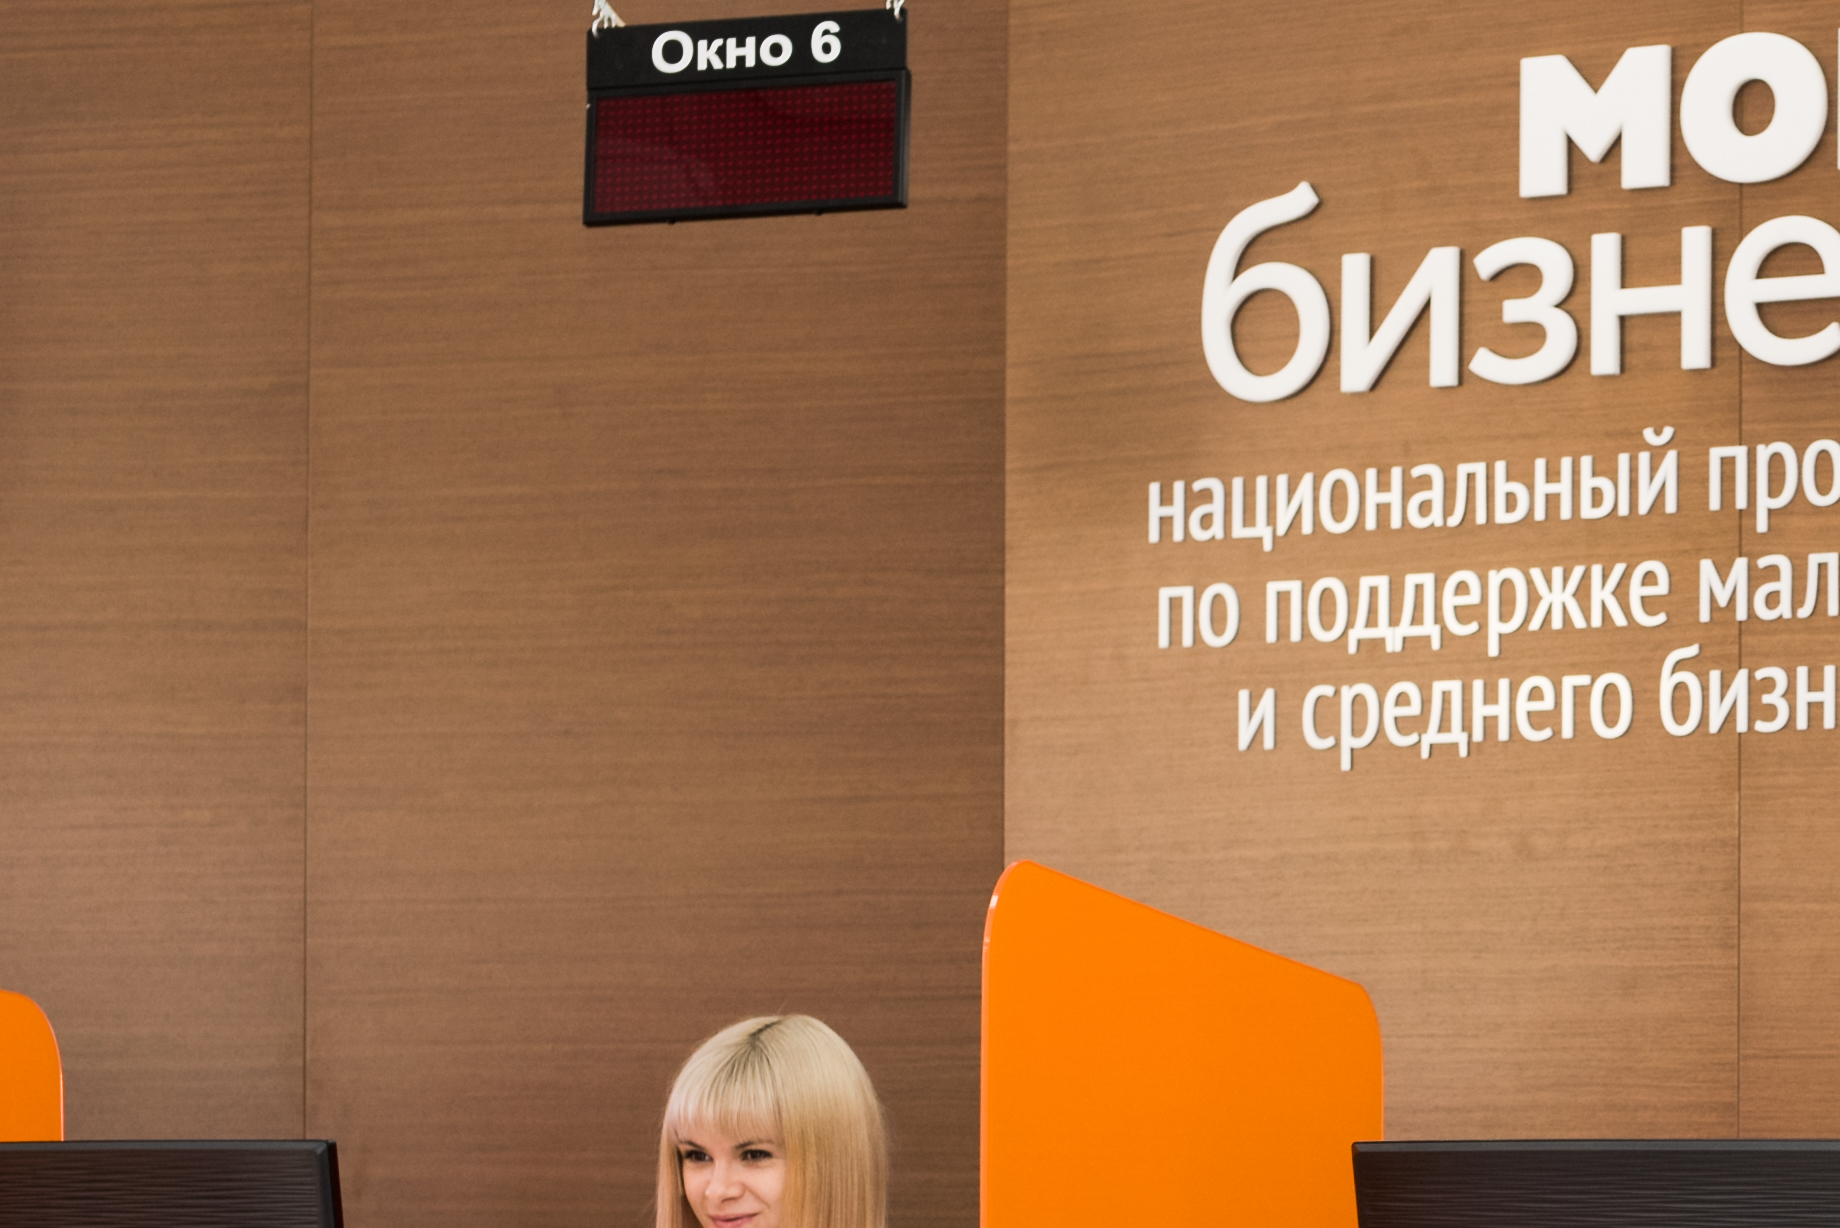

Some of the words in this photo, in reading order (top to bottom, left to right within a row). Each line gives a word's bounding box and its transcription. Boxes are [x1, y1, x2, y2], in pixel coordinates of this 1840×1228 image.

[651, 29, 793, 74] Окно
[810, 20, 842, 64] 6
[1148, 426, 1679, 552] национальный
[1158, 582, 1240, 649] по
[1265, 560, 1670, 658] поддержке
[1238, 687, 1276, 752] и
[1302, 672, 1633, 772] среднего
